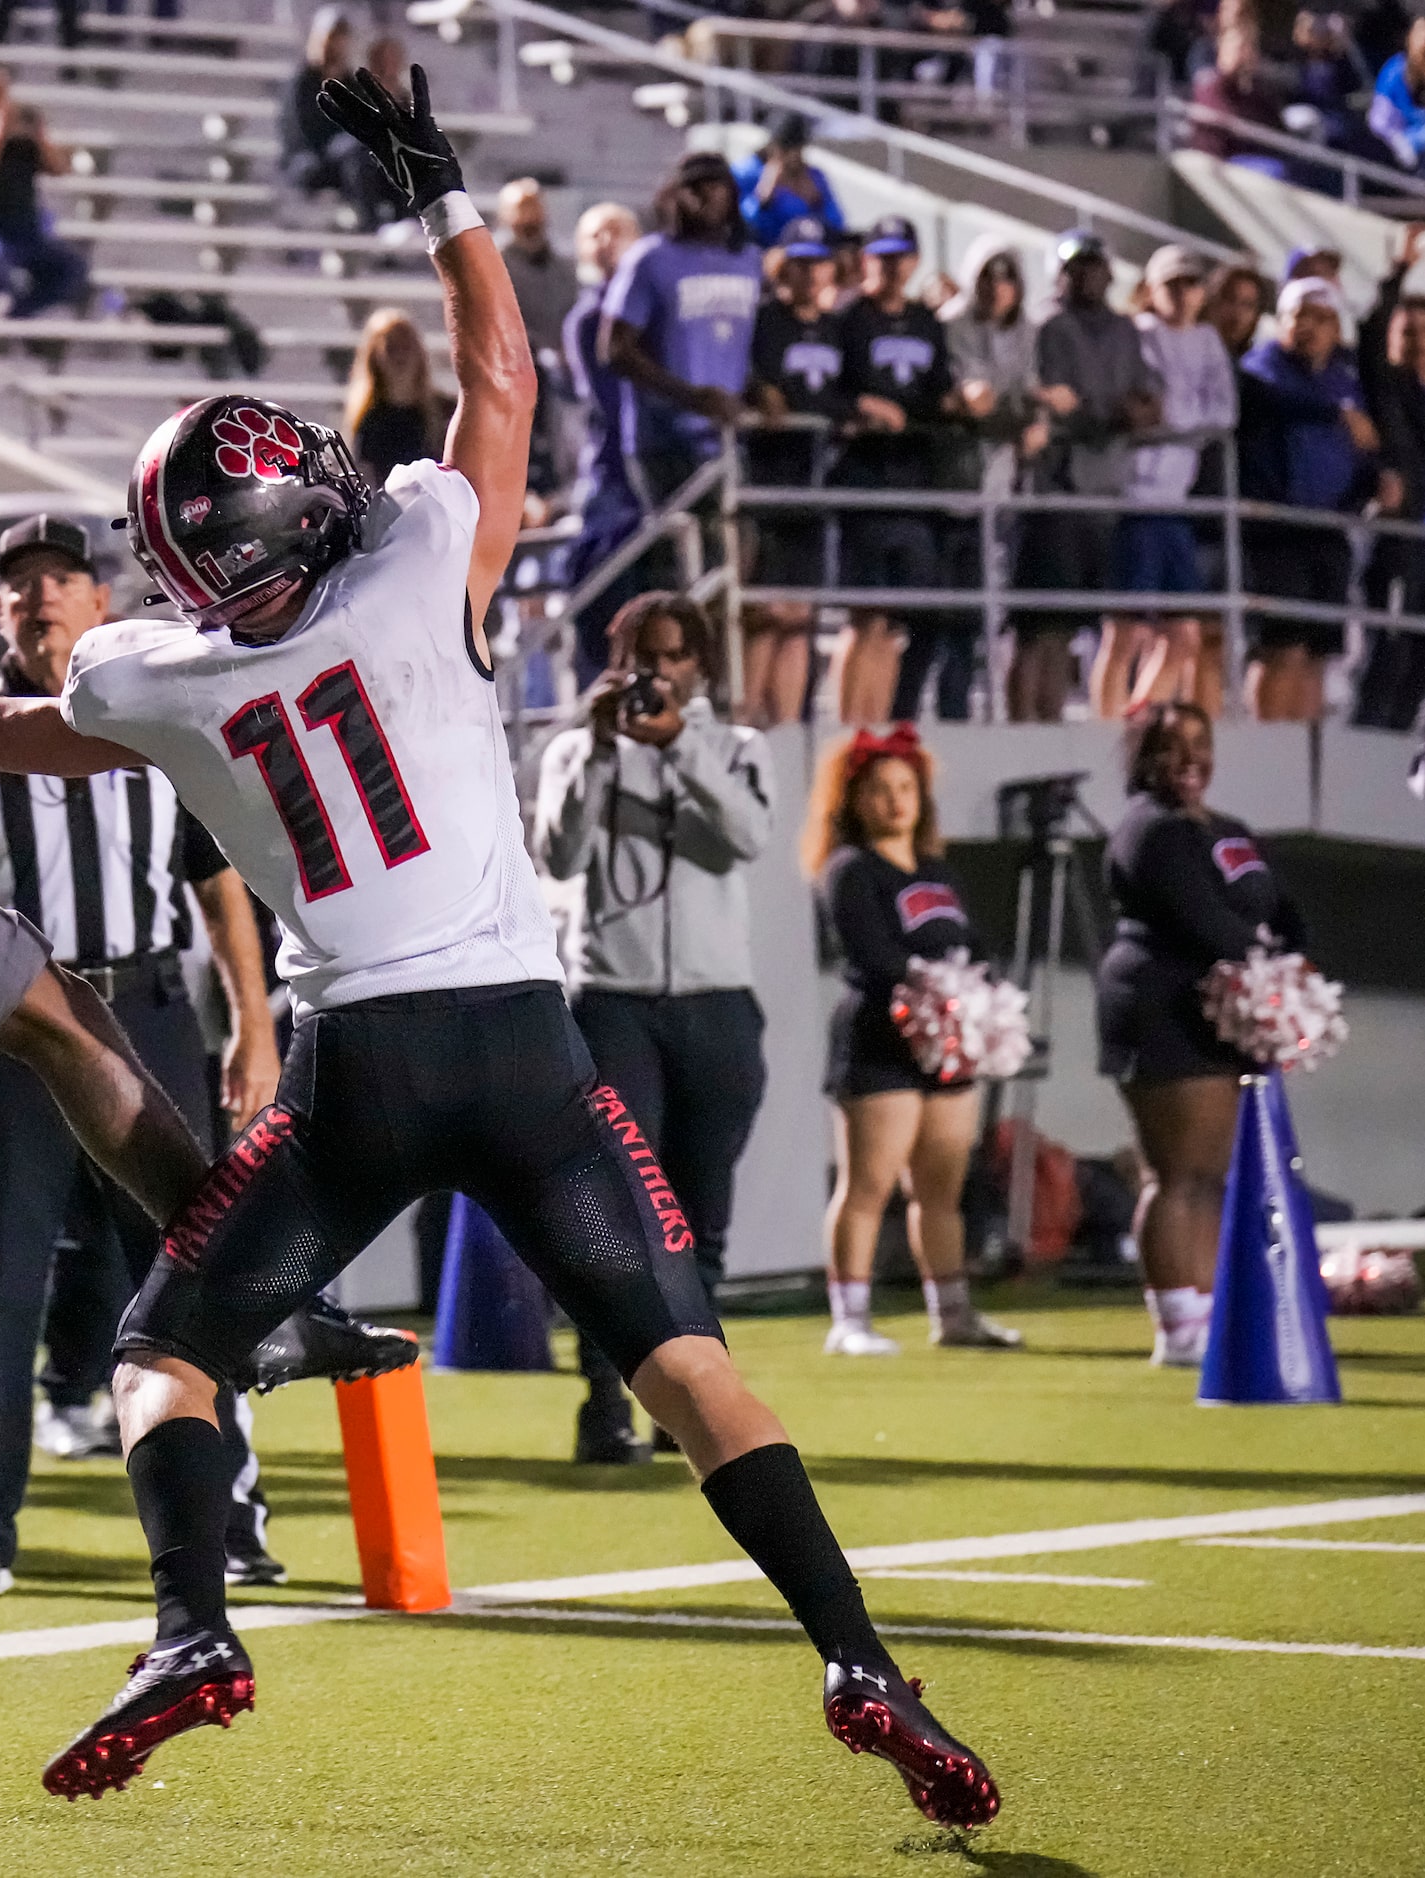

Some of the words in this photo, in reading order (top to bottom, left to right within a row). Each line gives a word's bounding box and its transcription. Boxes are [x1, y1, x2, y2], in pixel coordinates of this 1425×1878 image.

[221, 659, 432, 904] 11
[164, 1106, 294, 1273] PANTHERS
[590, 1084, 695, 1253] PANTHERS
